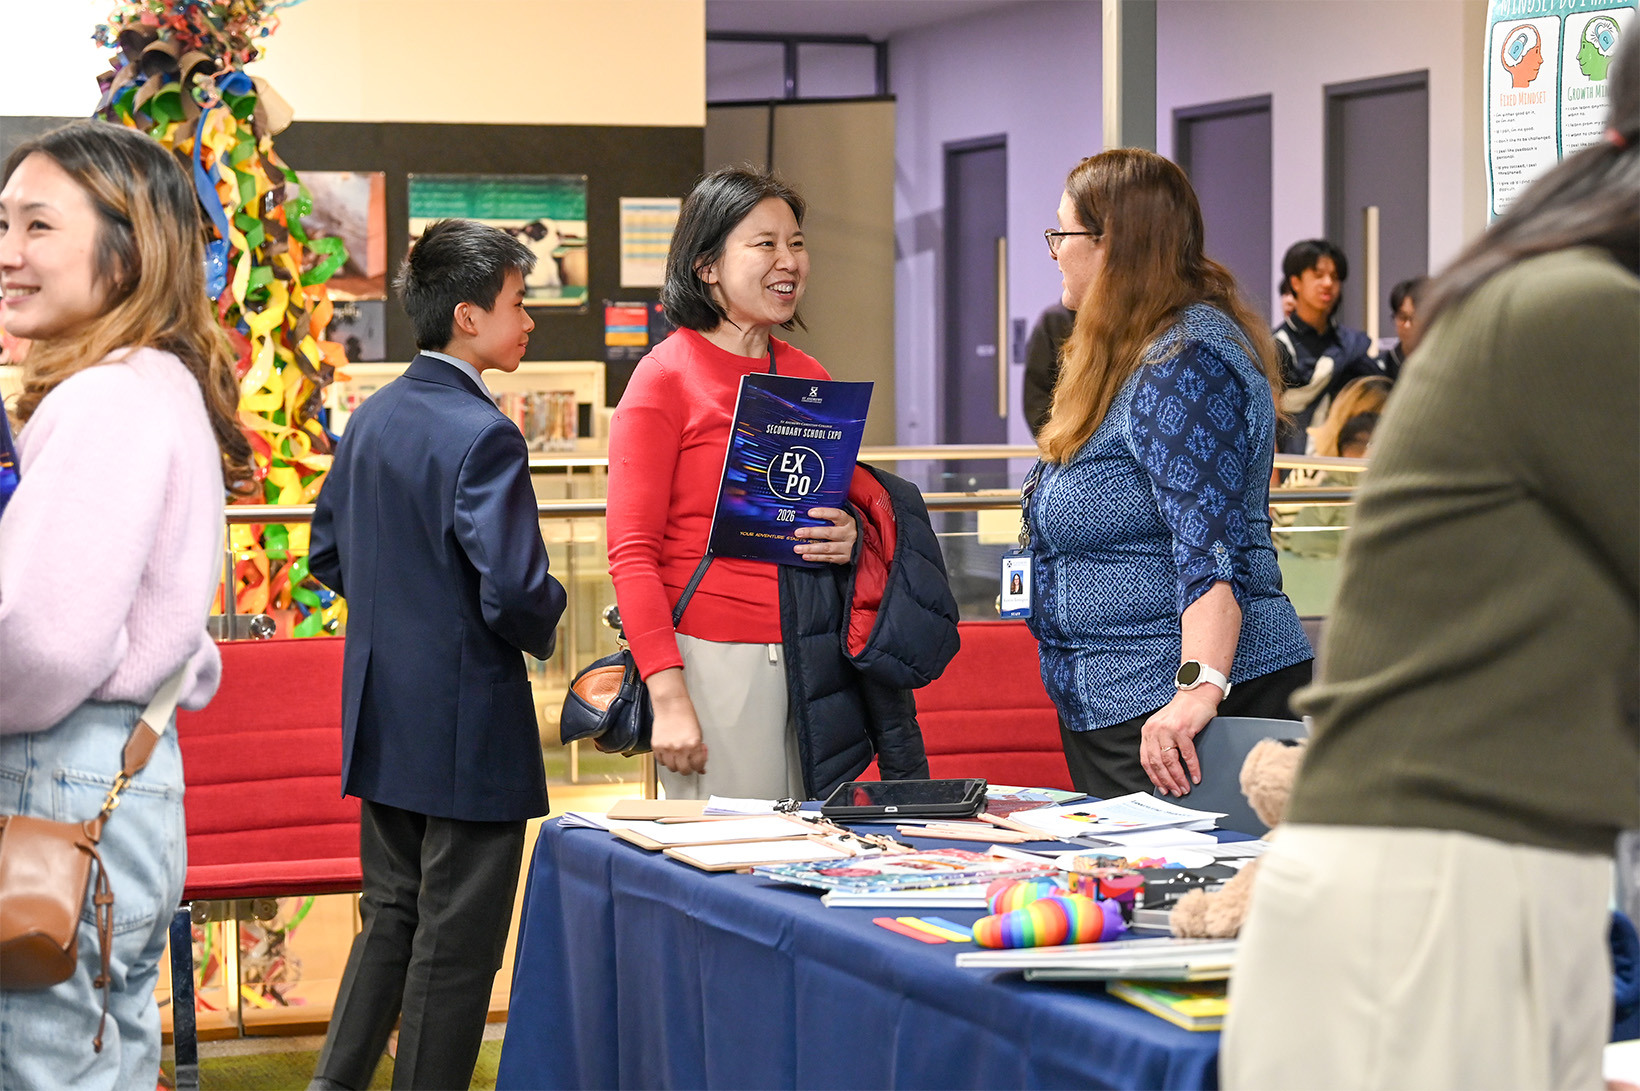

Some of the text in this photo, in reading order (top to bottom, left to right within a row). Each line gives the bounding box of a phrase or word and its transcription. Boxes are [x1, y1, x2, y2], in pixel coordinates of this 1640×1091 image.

[1500, 91, 1546, 106] FIXED MINDSET
[1568, 87, 1593, 101] GROWTH
[766, 424, 842, 440] SECONDARY SCHOOL EXPO
[780, 452, 807, 474] EX
[785, 474, 811, 496] PO
[776, 508, 796, 522] 2026
